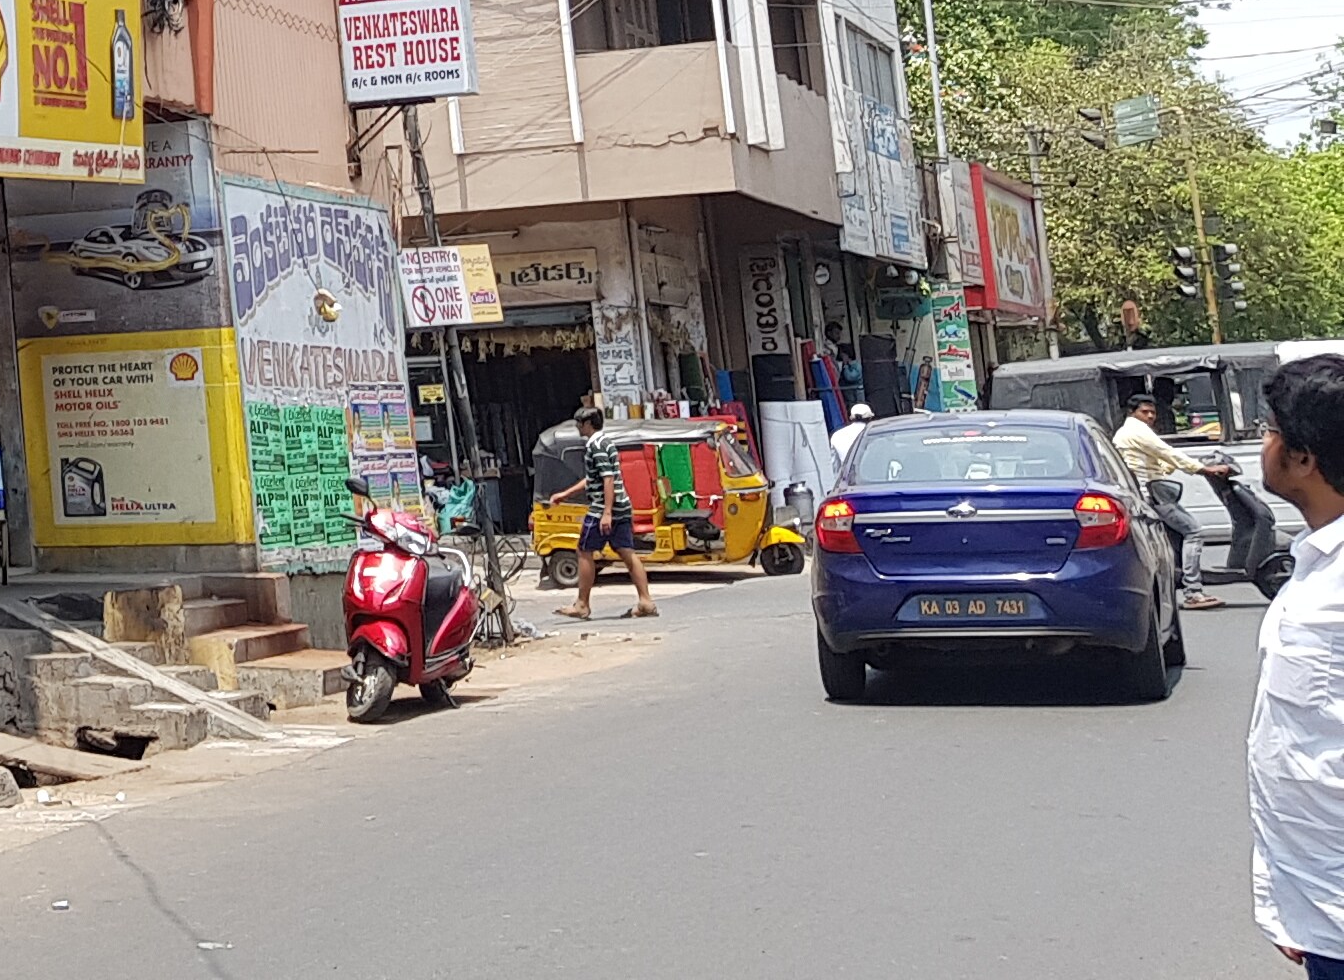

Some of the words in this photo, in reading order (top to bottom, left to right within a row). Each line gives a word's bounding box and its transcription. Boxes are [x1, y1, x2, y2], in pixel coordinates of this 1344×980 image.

[344, 6, 460, 41] VENKATESWARA
[352, 42, 397, 71] REST
[403, 37, 461, 66] HOUSE
[371, 76, 378, 86] &
[381, 74, 403, 85] NON
[424, 69, 460, 82] ROOMS
[162, 140, 172, 151] A
[144, 153, 194, 169] RRANTY?
[406, 251, 420, 265] NO
[422, 250, 451, 264] ENTRY
[435, 286, 463, 303] ONE
[438, 304, 463, 320] WAY
[51, 364, 95, 375] PROTECT
[98, 364, 116, 374] THE
[119, 362, 153, 372] HEART
[240, 337, 399, 390] VENKATESWARA
[53, 378, 67, 387] OF
[69, 376, 99, 386] YOUR
[102, 375, 123, 385] CAR
[126, 374, 154, 384] WITH
[54, 390, 82, 399] SHELL
[85, 388, 114, 398] HELIX
[55, 402, 93, 412] MOTOR
[56, 421, 73, 429] TOLL
[75, 421, 92, 429] FREE
[250, 420, 269, 435] ALP
[284, 424, 302, 439] ALP
[317, 425, 334, 439] ALP
[111, 501, 144, 511] HELIX
[144, 502, 177, 511] ULTRA
[256, 492, 275, 507] ALP
[291, 493, 309, 508] ALP
[323, 493, 341, 507] ALP
[920, 600, 940, 615] KA
[945, 599, 960, 615] 03
[967, 599, 986, 614] AD
[995, 599, 1025, 614] 7431
